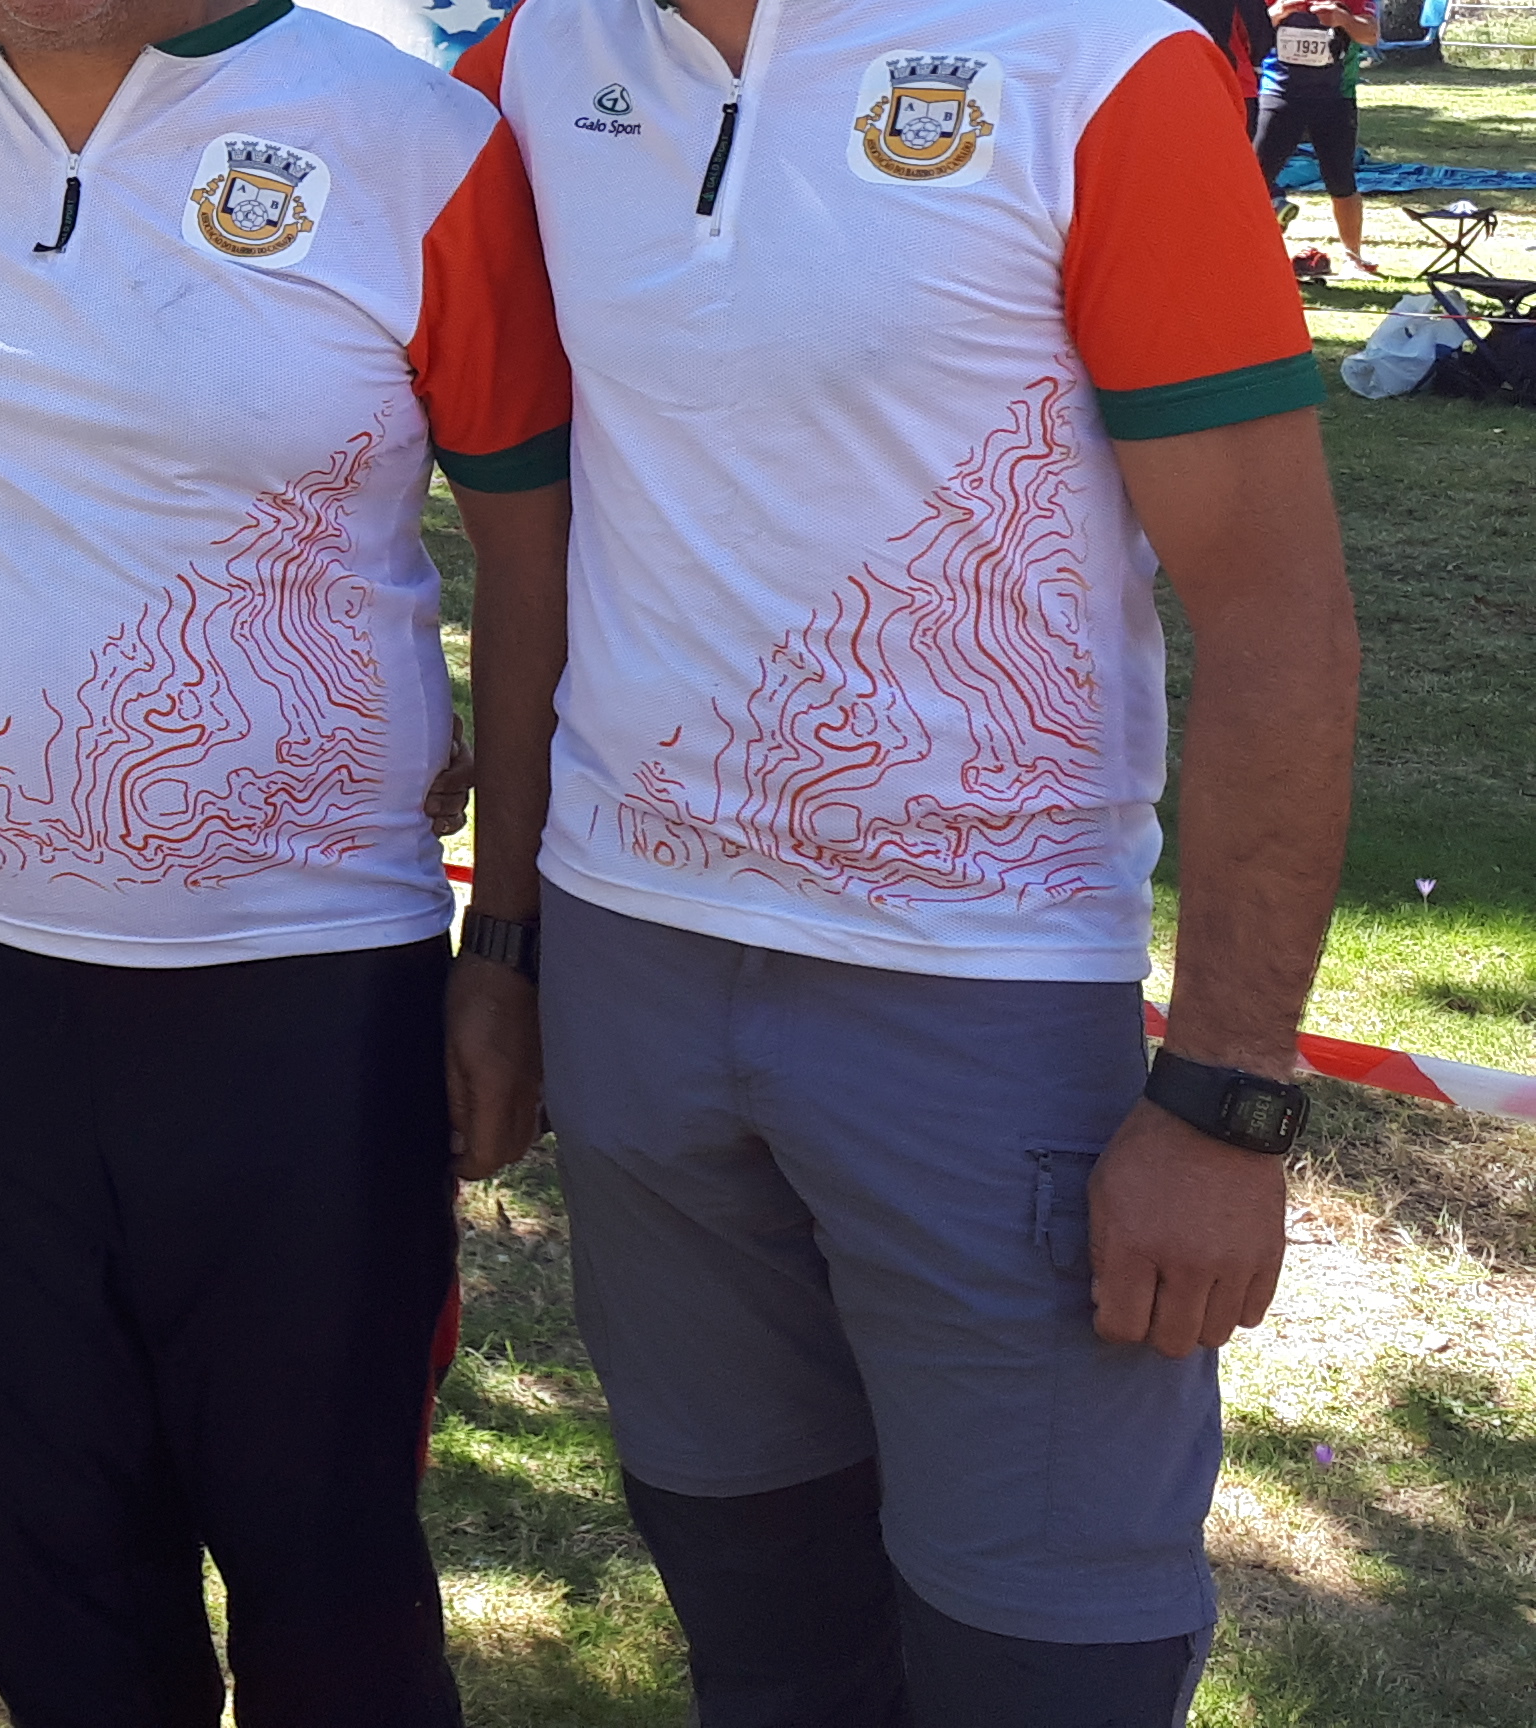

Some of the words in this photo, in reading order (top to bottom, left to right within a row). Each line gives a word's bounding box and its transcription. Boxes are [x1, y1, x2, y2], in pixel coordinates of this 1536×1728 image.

[1296, 39, 1327, 56] 1937
[574, 117, 607, 135] Galo
[608, 119, 642, 137] Sport
